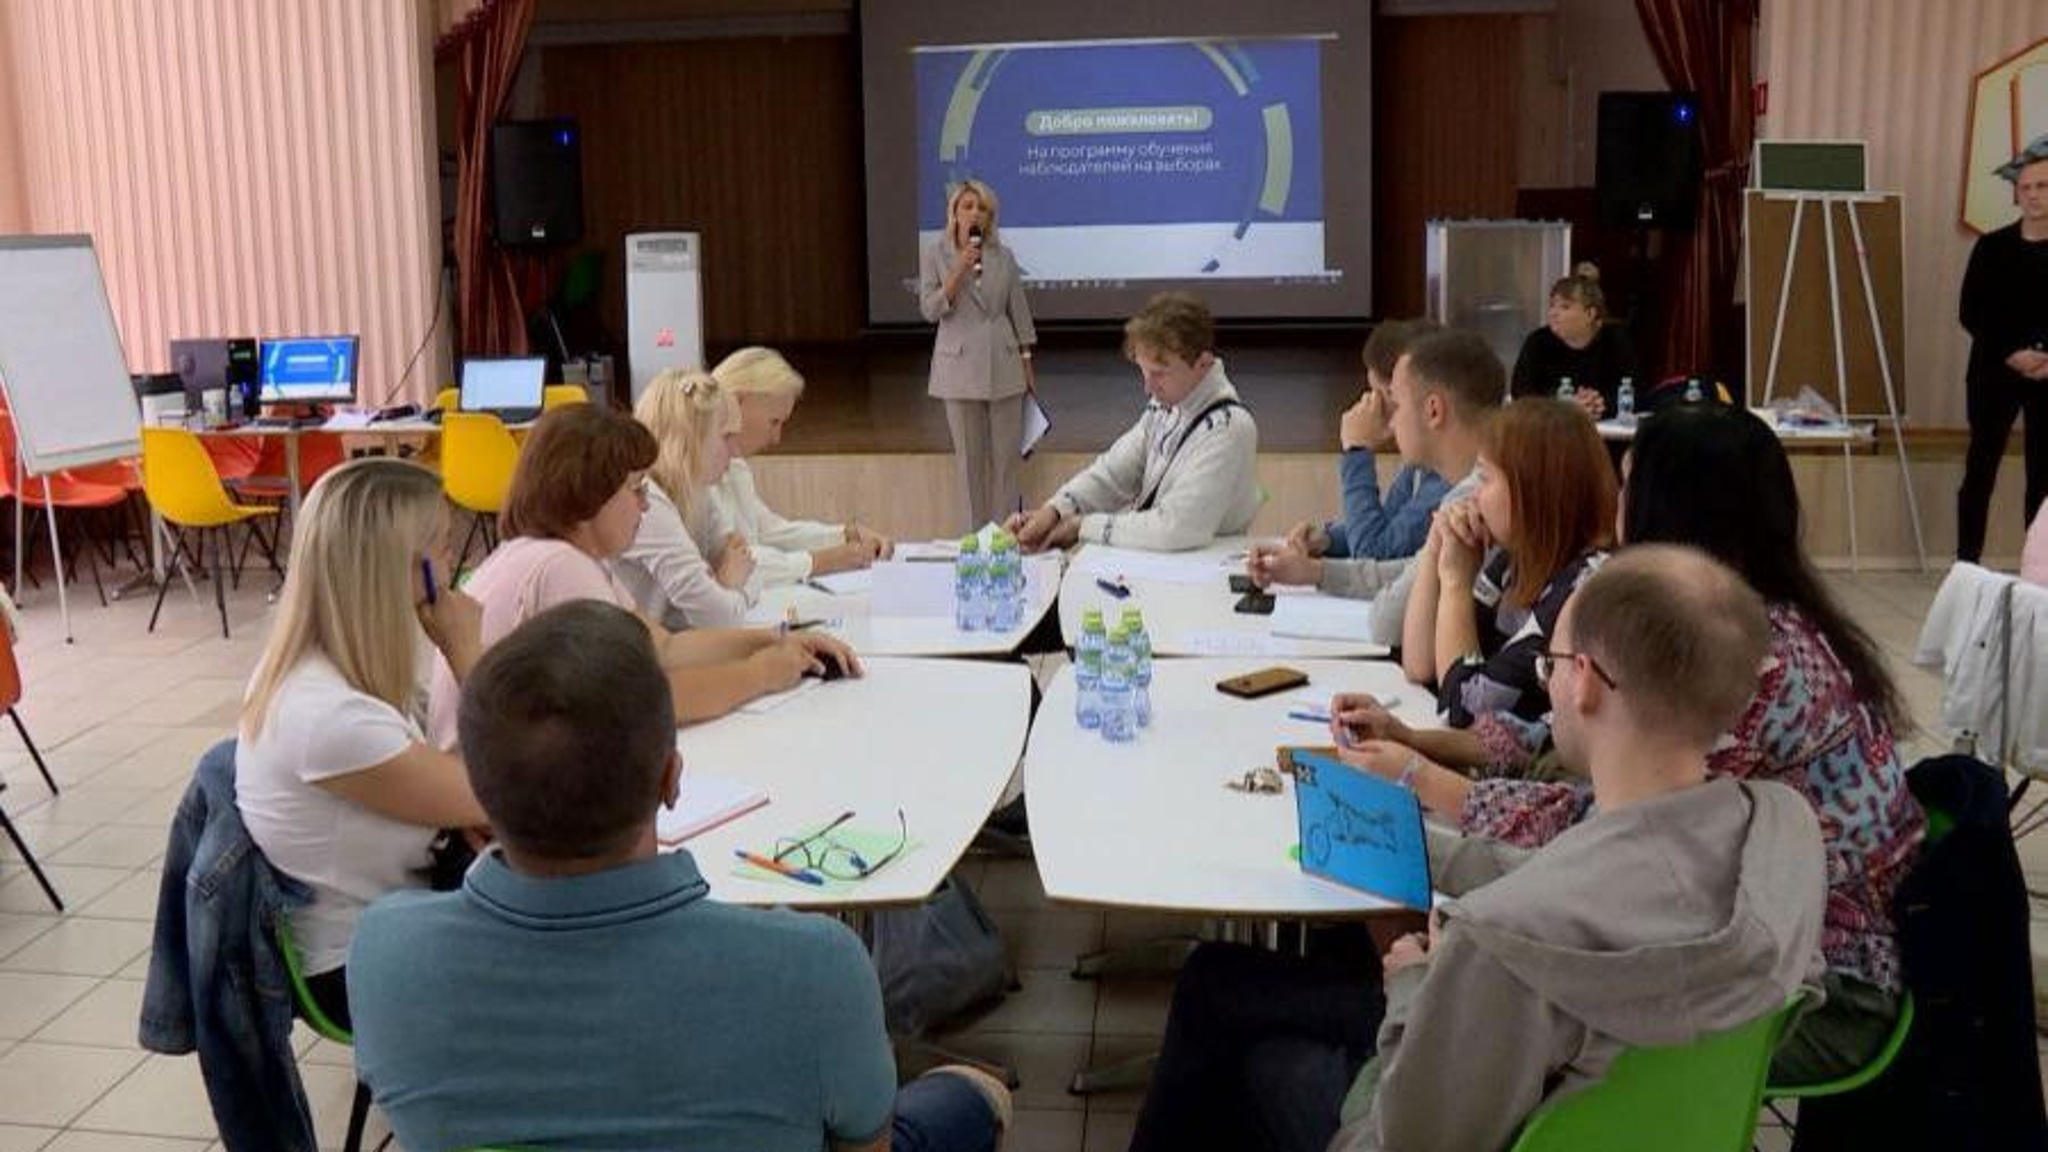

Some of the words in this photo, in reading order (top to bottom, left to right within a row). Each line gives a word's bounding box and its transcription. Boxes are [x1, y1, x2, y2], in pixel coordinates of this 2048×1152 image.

[1027, 145, 1048, 159] На
[1050, 144, 1136, 160] программу
[1137, 141, 1213, 156] обучения
[1019, 157, 1133, 175] наблюдателей
[1135, 160, 1152, 171] на
[1155, 158, 1221, 171] выборах
